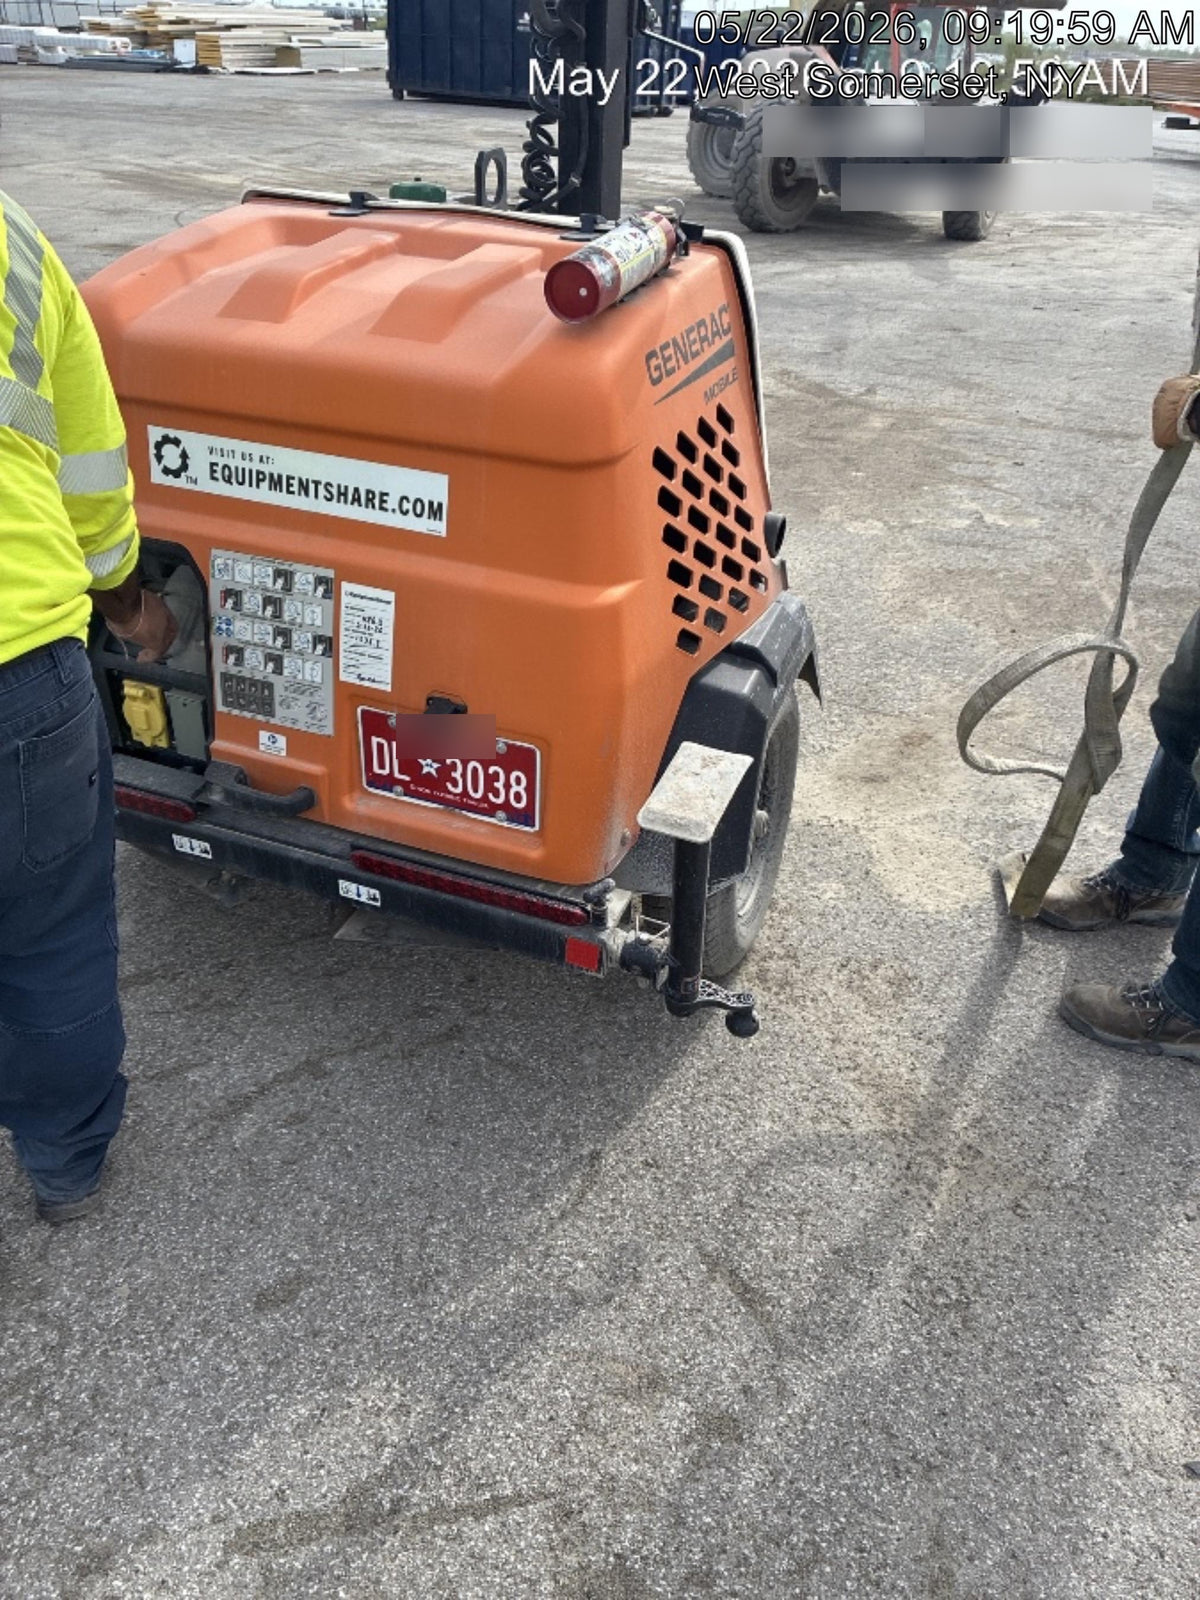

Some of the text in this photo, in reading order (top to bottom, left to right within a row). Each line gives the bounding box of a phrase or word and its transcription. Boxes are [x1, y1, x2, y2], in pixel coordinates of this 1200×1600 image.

[645, 303, 732, 387] GENERAC
[704, 366, 739, 405] MOBILE
[207, 445, 275, 465] VISIT US AT:
[208, 461, 444, 522] EQUIPMENTSHARE.COM
[370, 735, 411, 781] DL
[445, 758, 528, 809] 3038
